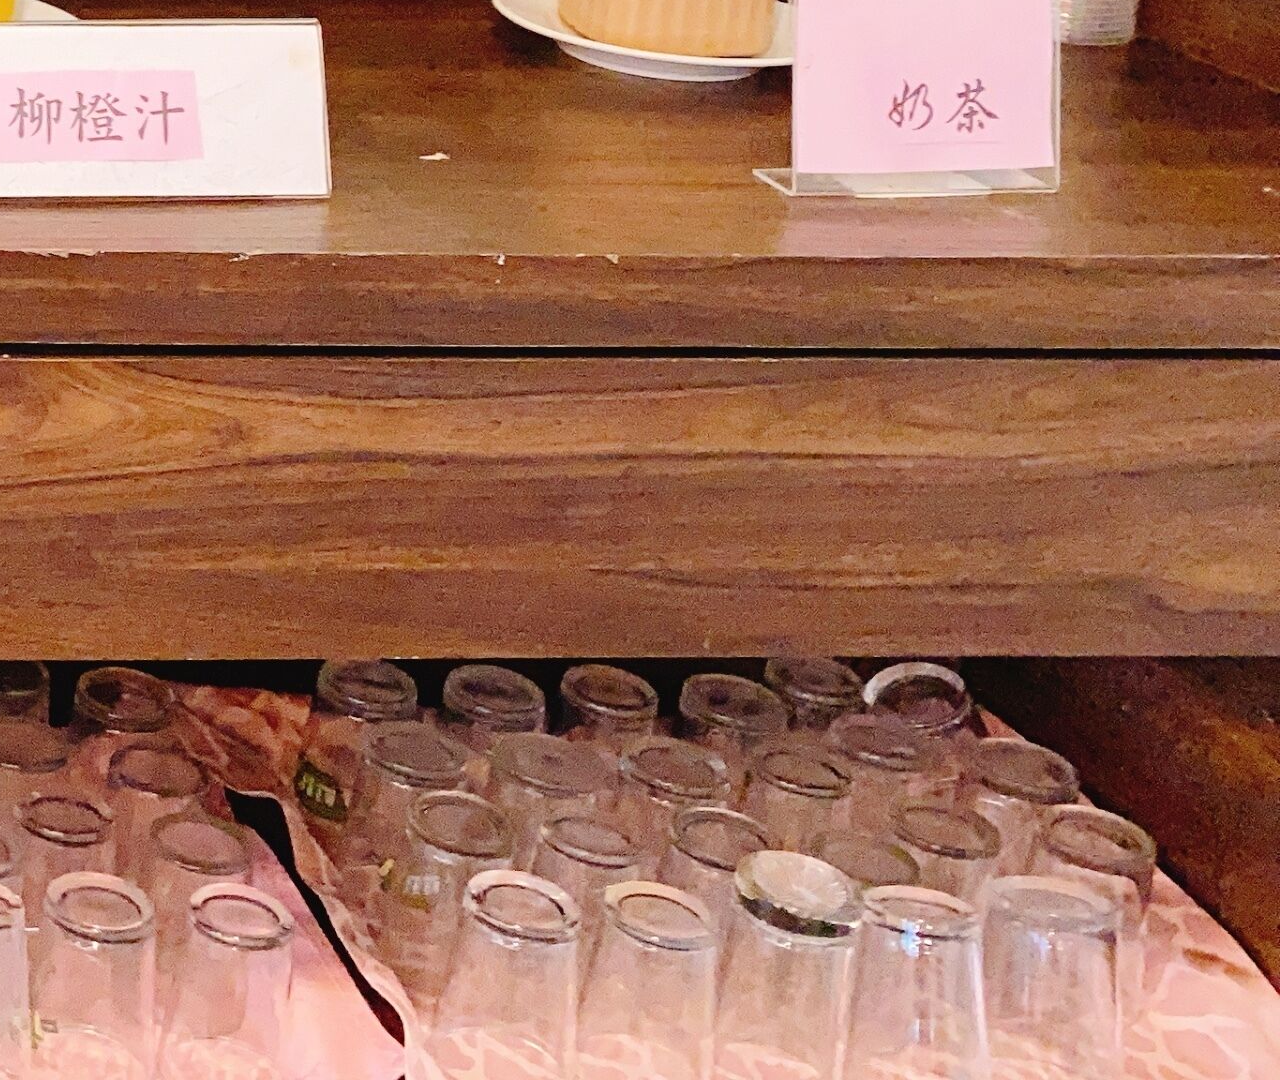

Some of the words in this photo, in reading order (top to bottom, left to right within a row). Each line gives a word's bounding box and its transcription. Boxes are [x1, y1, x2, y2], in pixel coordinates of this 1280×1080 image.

[8, 86, 186, 146] 柳橙汁
[888, 78, 1000, 133] 奶茶
